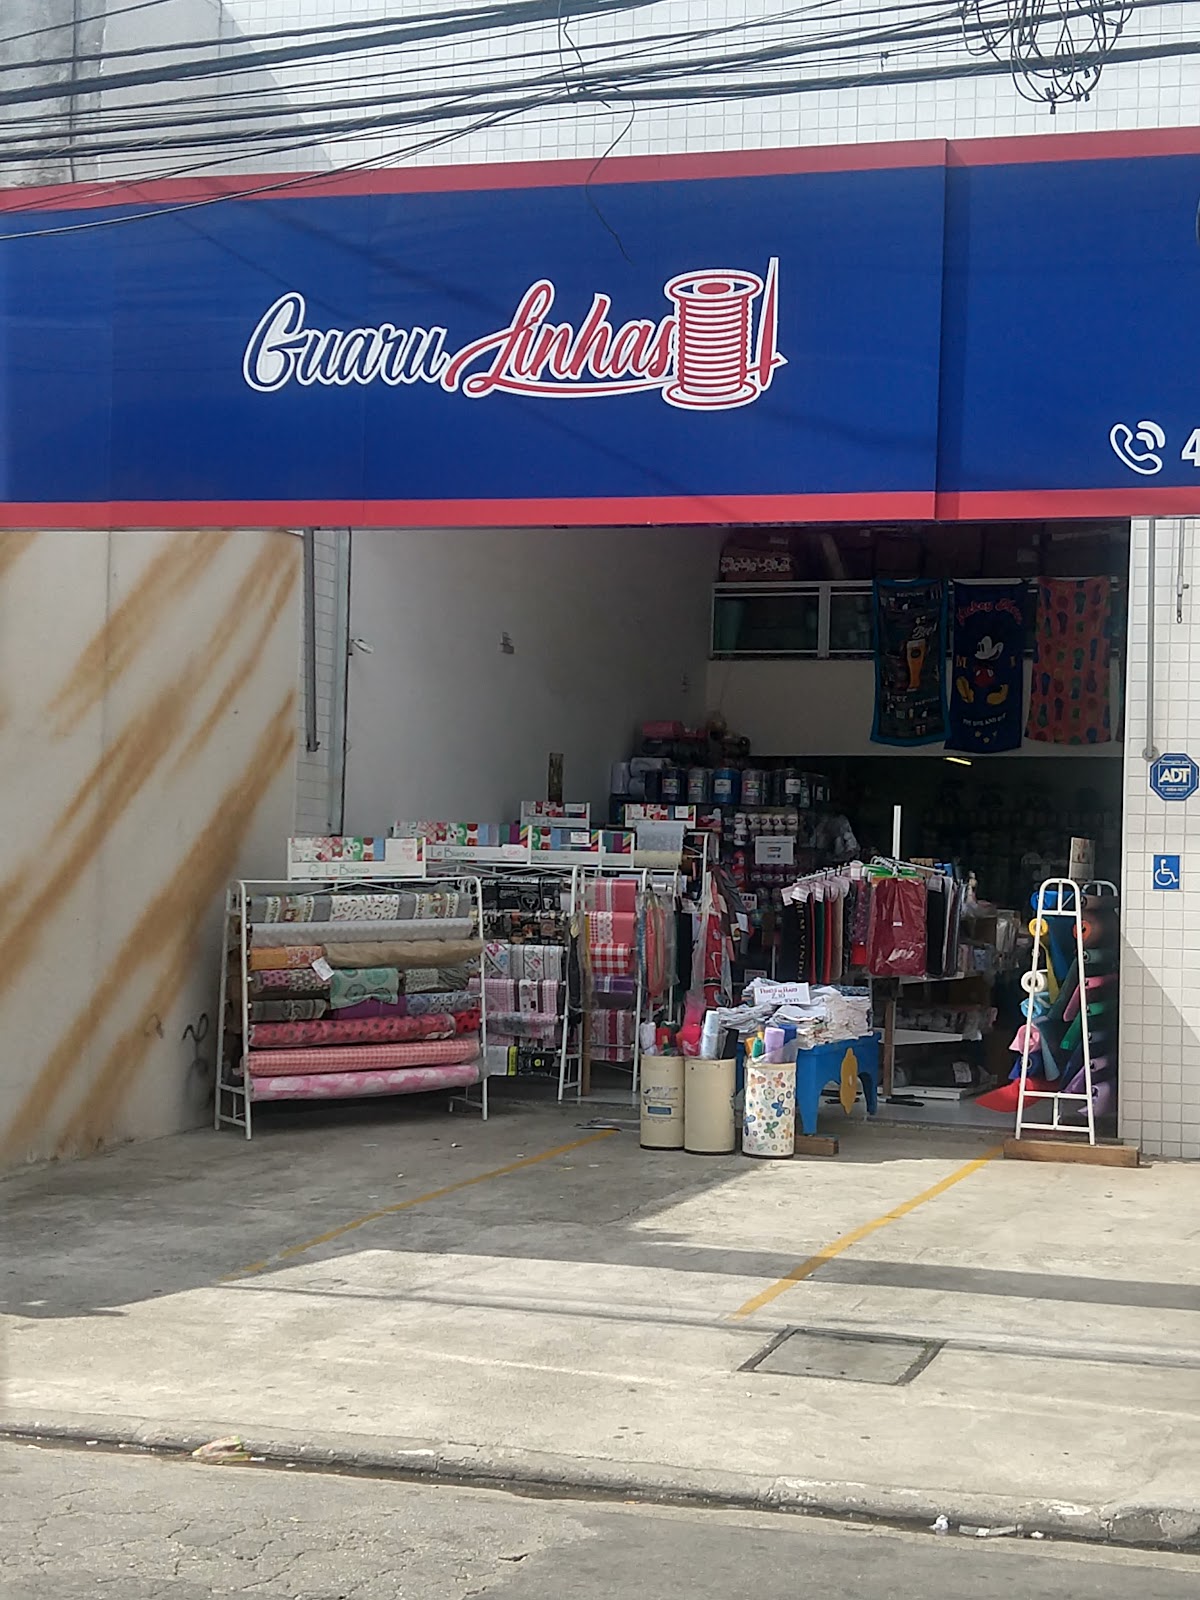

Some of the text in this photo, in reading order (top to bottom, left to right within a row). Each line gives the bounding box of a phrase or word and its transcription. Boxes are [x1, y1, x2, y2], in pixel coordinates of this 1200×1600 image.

[243, 279, 676, 399] Guaru Linhas
[1159, 768, 1190, 783] ADT
[431, 846, 442, 858] Le
[325, 863, 337, 875] Le
